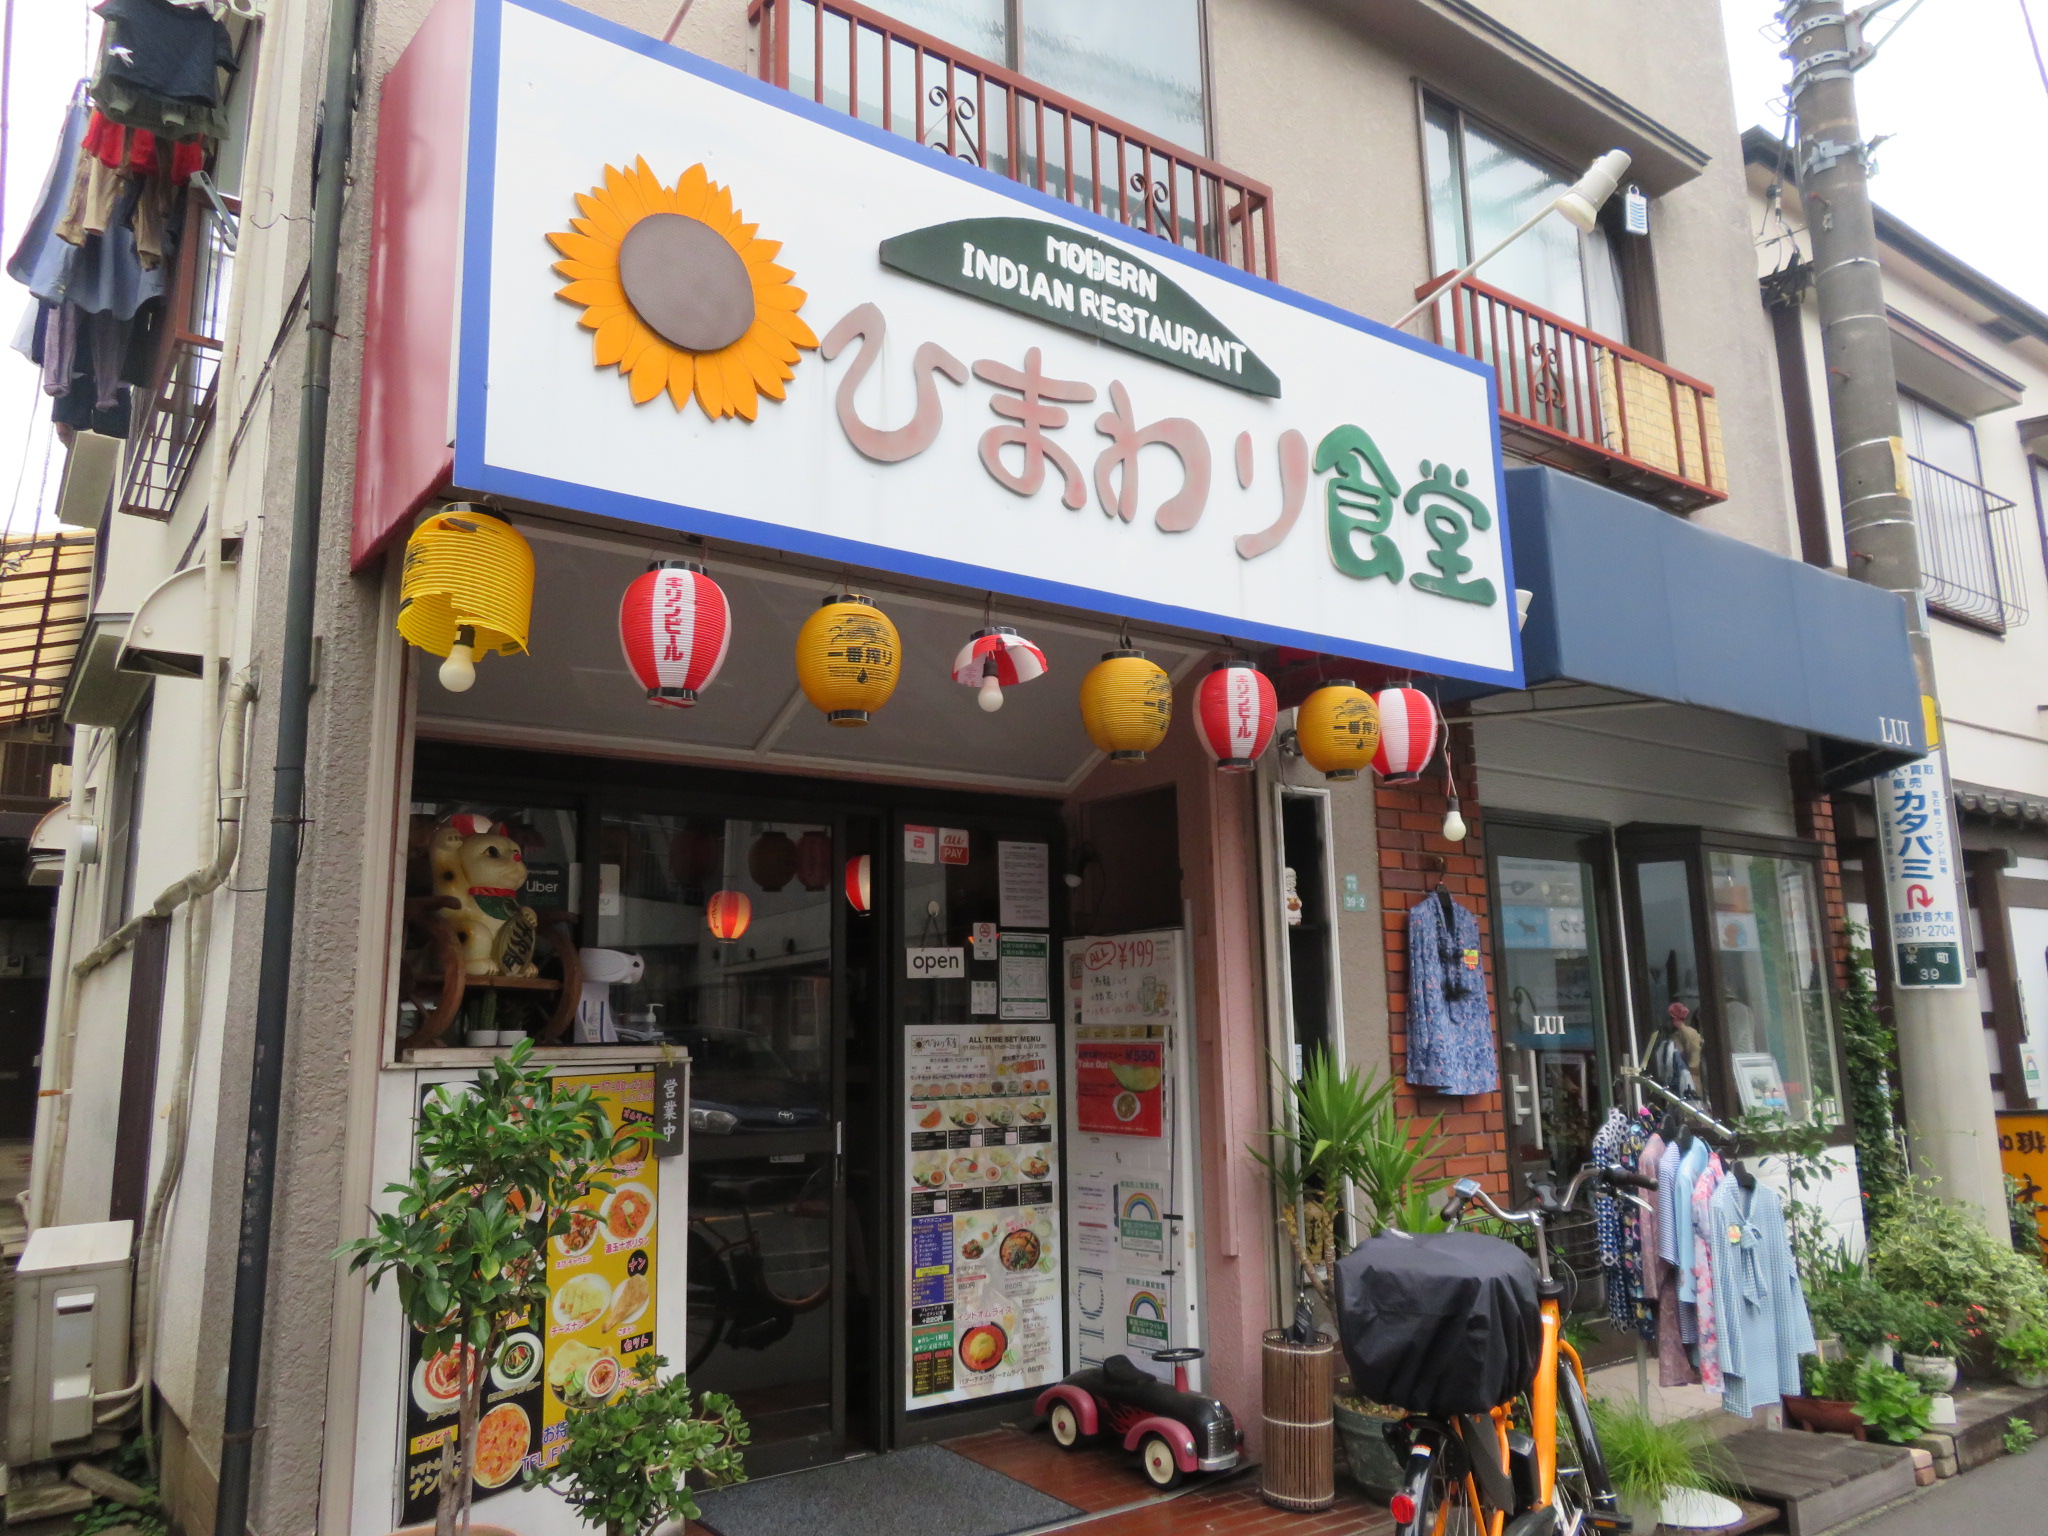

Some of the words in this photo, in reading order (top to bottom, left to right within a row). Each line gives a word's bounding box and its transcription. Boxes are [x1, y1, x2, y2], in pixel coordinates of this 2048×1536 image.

[1046, 235, 1157, 302] MODERN
[962, 242, 1074, 312] INDIAN
[1080, 287, 1247, 374] RESTAURANT
[822, 301, 1497, 606] ひまわり食堂
[664, 576, 684, 662] キリンビール
[827, 645, 893, 667] 一番搾り
[1234, 674, 1252, 739] キリンビール
[1879, 716, 1912, 747] LUI
[943, 834, 964, 845] au
[1895, 790, 1934, 880] カタバミ
[943, 848, 963, 859] PAY
[526, 880, 560, 893] Uber
[1895, 925, 1956, 938] 3991-2704
[1089, 947, 1109, 967] ALL
[1117, 938, 1154, 969] ¥199
[913, 954, 960, 974] open
[1920, 968, 1940, 981] 39
[1533, 1015, 1567, 1035] LUI
[968, 1036, 981, 1044] ALL
[984, 1036, 1003, 1044] TIME
[1003, 1036, 1018, 1044] SET
[1019, 1036, 1041, 1044] MENU
[1078, 1060, 1094, 1069] Take
[1095, 1061, 1108, 1069] Out
[662, 1078, 679, 1142] 営業中
[628, 1256, 647, 1273] ナン
[550, 1320, 586, 1337] チーズナン
[623, 1335, 648, 1351] セット
